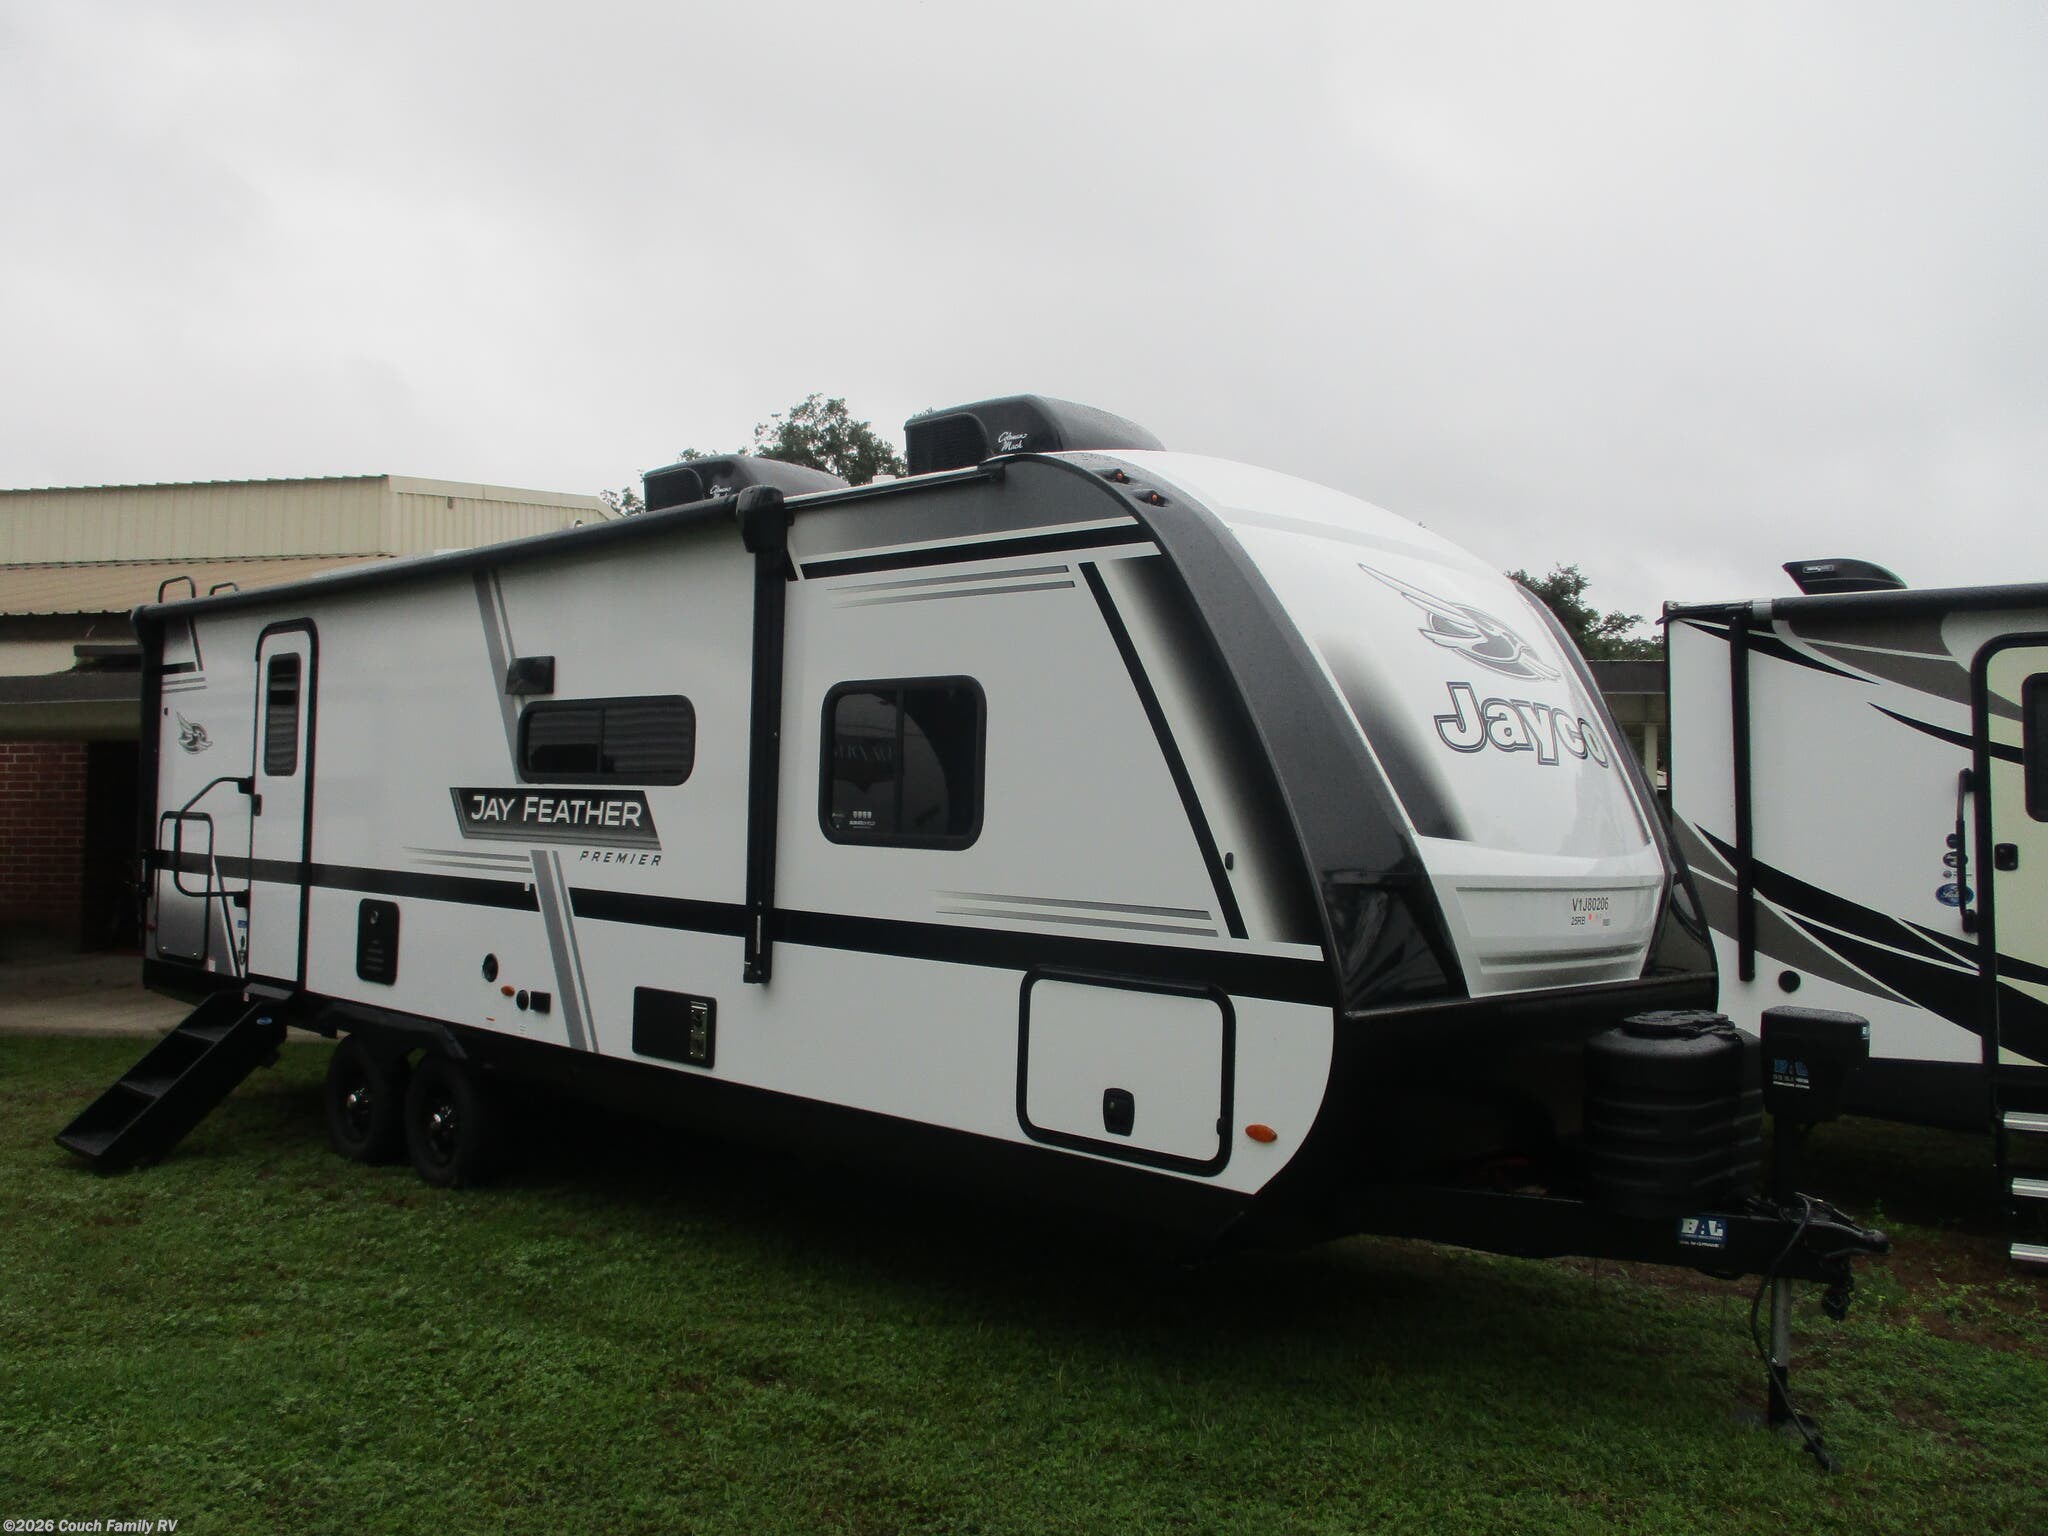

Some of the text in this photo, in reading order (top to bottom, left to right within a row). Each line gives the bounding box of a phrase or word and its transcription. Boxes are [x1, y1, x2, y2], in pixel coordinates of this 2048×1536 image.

[1433, 681, 1609, 769] Jayco
[471, 795, 642, 827] JAY FEATHER
[579, 850, 662, 867] PREMIER
[1681, 1218, 1723, 1237] BAL
